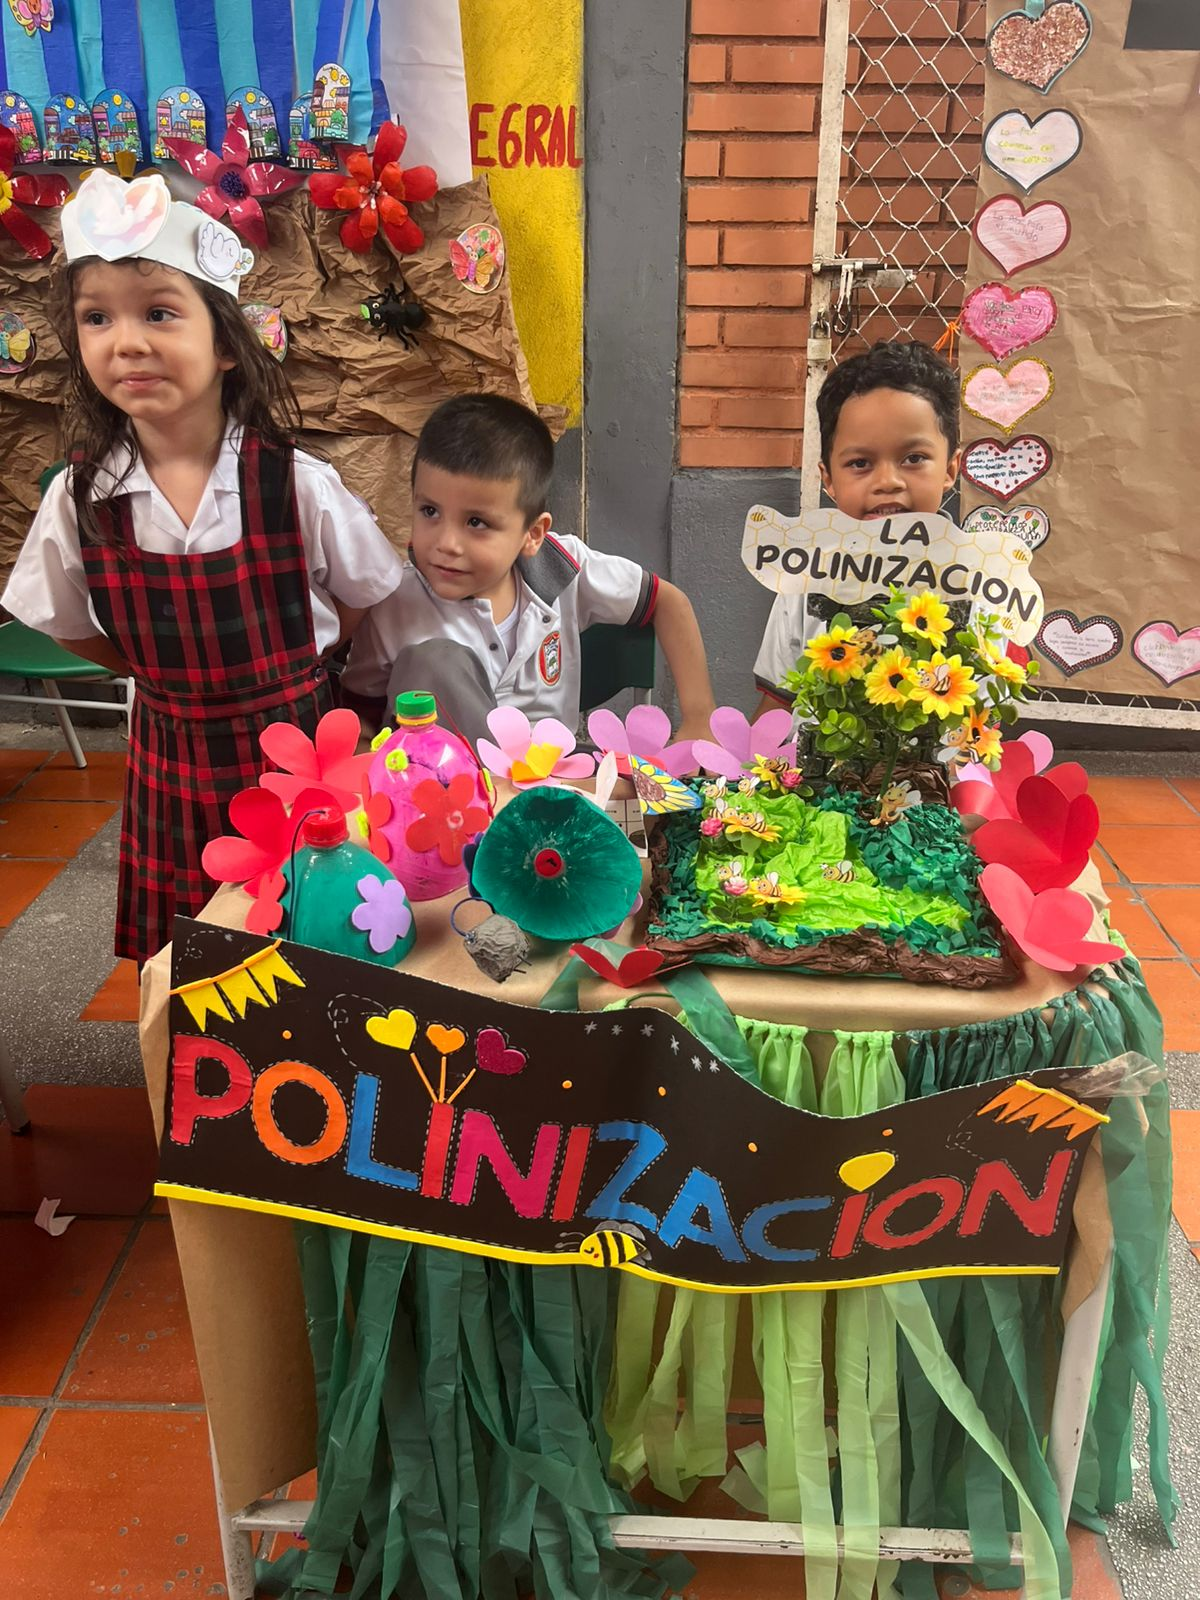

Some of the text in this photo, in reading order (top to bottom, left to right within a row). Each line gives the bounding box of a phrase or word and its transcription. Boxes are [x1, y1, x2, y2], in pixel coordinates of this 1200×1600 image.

[880, 518, 931, 547] LA
[756, 544, 1038, 622] POLINIZACION
[170, 1032, 1075, 1263] POLINIZACION
